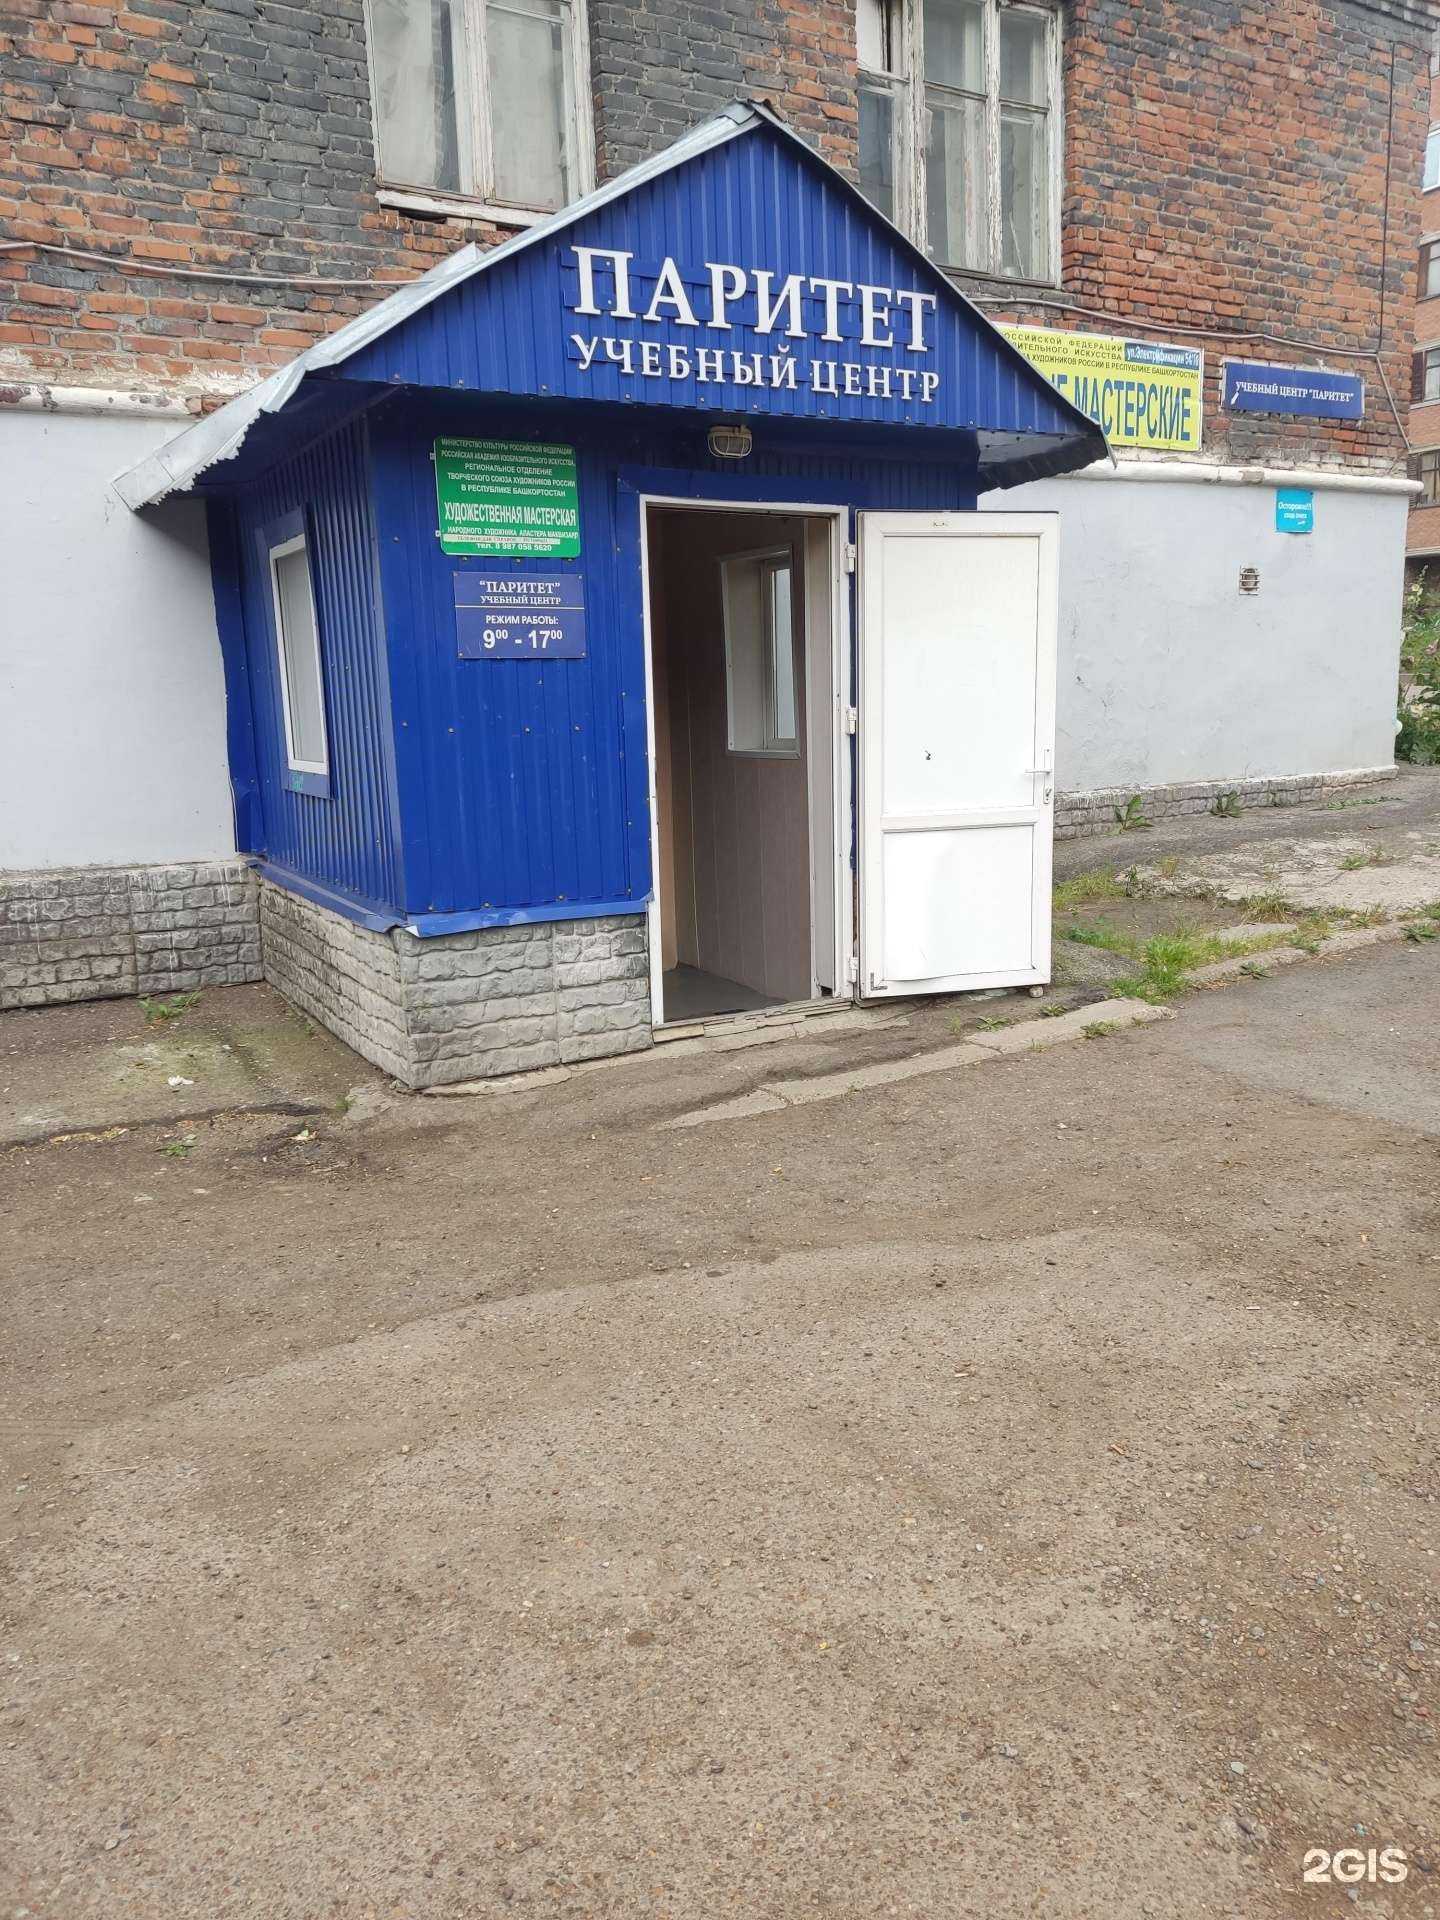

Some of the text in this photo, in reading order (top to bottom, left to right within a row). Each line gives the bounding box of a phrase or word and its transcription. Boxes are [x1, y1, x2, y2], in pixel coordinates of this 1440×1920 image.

[570, 245, 936, 352] ПАРИТЕТ
[1003, 331, 1123, 352] ОССИЙСКОЙ ФЕДЕРАЦИИ
[1013, 342, 1122, 361] ИТЕЛЬНОГО ИСКУССТВА
[570, 334, 940, 402] УЧЕБНЫЙ ЦЕНТР
[1032, 354, 1077, 366] ХУДОЖНИКОВ
[1078, 358, 1105, 368] РОССИИ
[1111, 363, 1151, 374] РЕСПУБЛИКЕ
[1152, 367, 1199, 379] БАШКОРТОСТАН
[1236, 381, 1355, 402] УЧЕБНЫЙ ЦЕНТР "ПАРИТЕТ"
[1074, 375, 1191, 441] МАСТЕРСКИЕ
[441, 438, 483, 449] МИНИСТЕРСТВО
[483, 441, 508, 450] КУЛЬТУРЫ
[441, 449, 473, 459] РОССИЙСКАЯ
[464, 463, 553, 476] РЕГИОНАЛЬНОЕ ОТДЕЛЕНИЕ
[447, 472, 576, 488] ТВОРЧЕСКОГО СОЮЗА ХУДОЖНИКОВ РОССИИ
[461, 484, 566, 497] В РЕСПУБЛИКЕ БАШКОРТОСТАН
[444, 501, 577, 527] ХУДОЖЕСТВЕННАЯ МАСТЕРСКАЯ
[447, 526, 482, 535] НАРОДНОГО
[480, 595, 561, 606] УЧЕБНЫЙ ЦЕНТР
[485, 615, 559, 625] РЕЖИМ РАБОТЫ:
